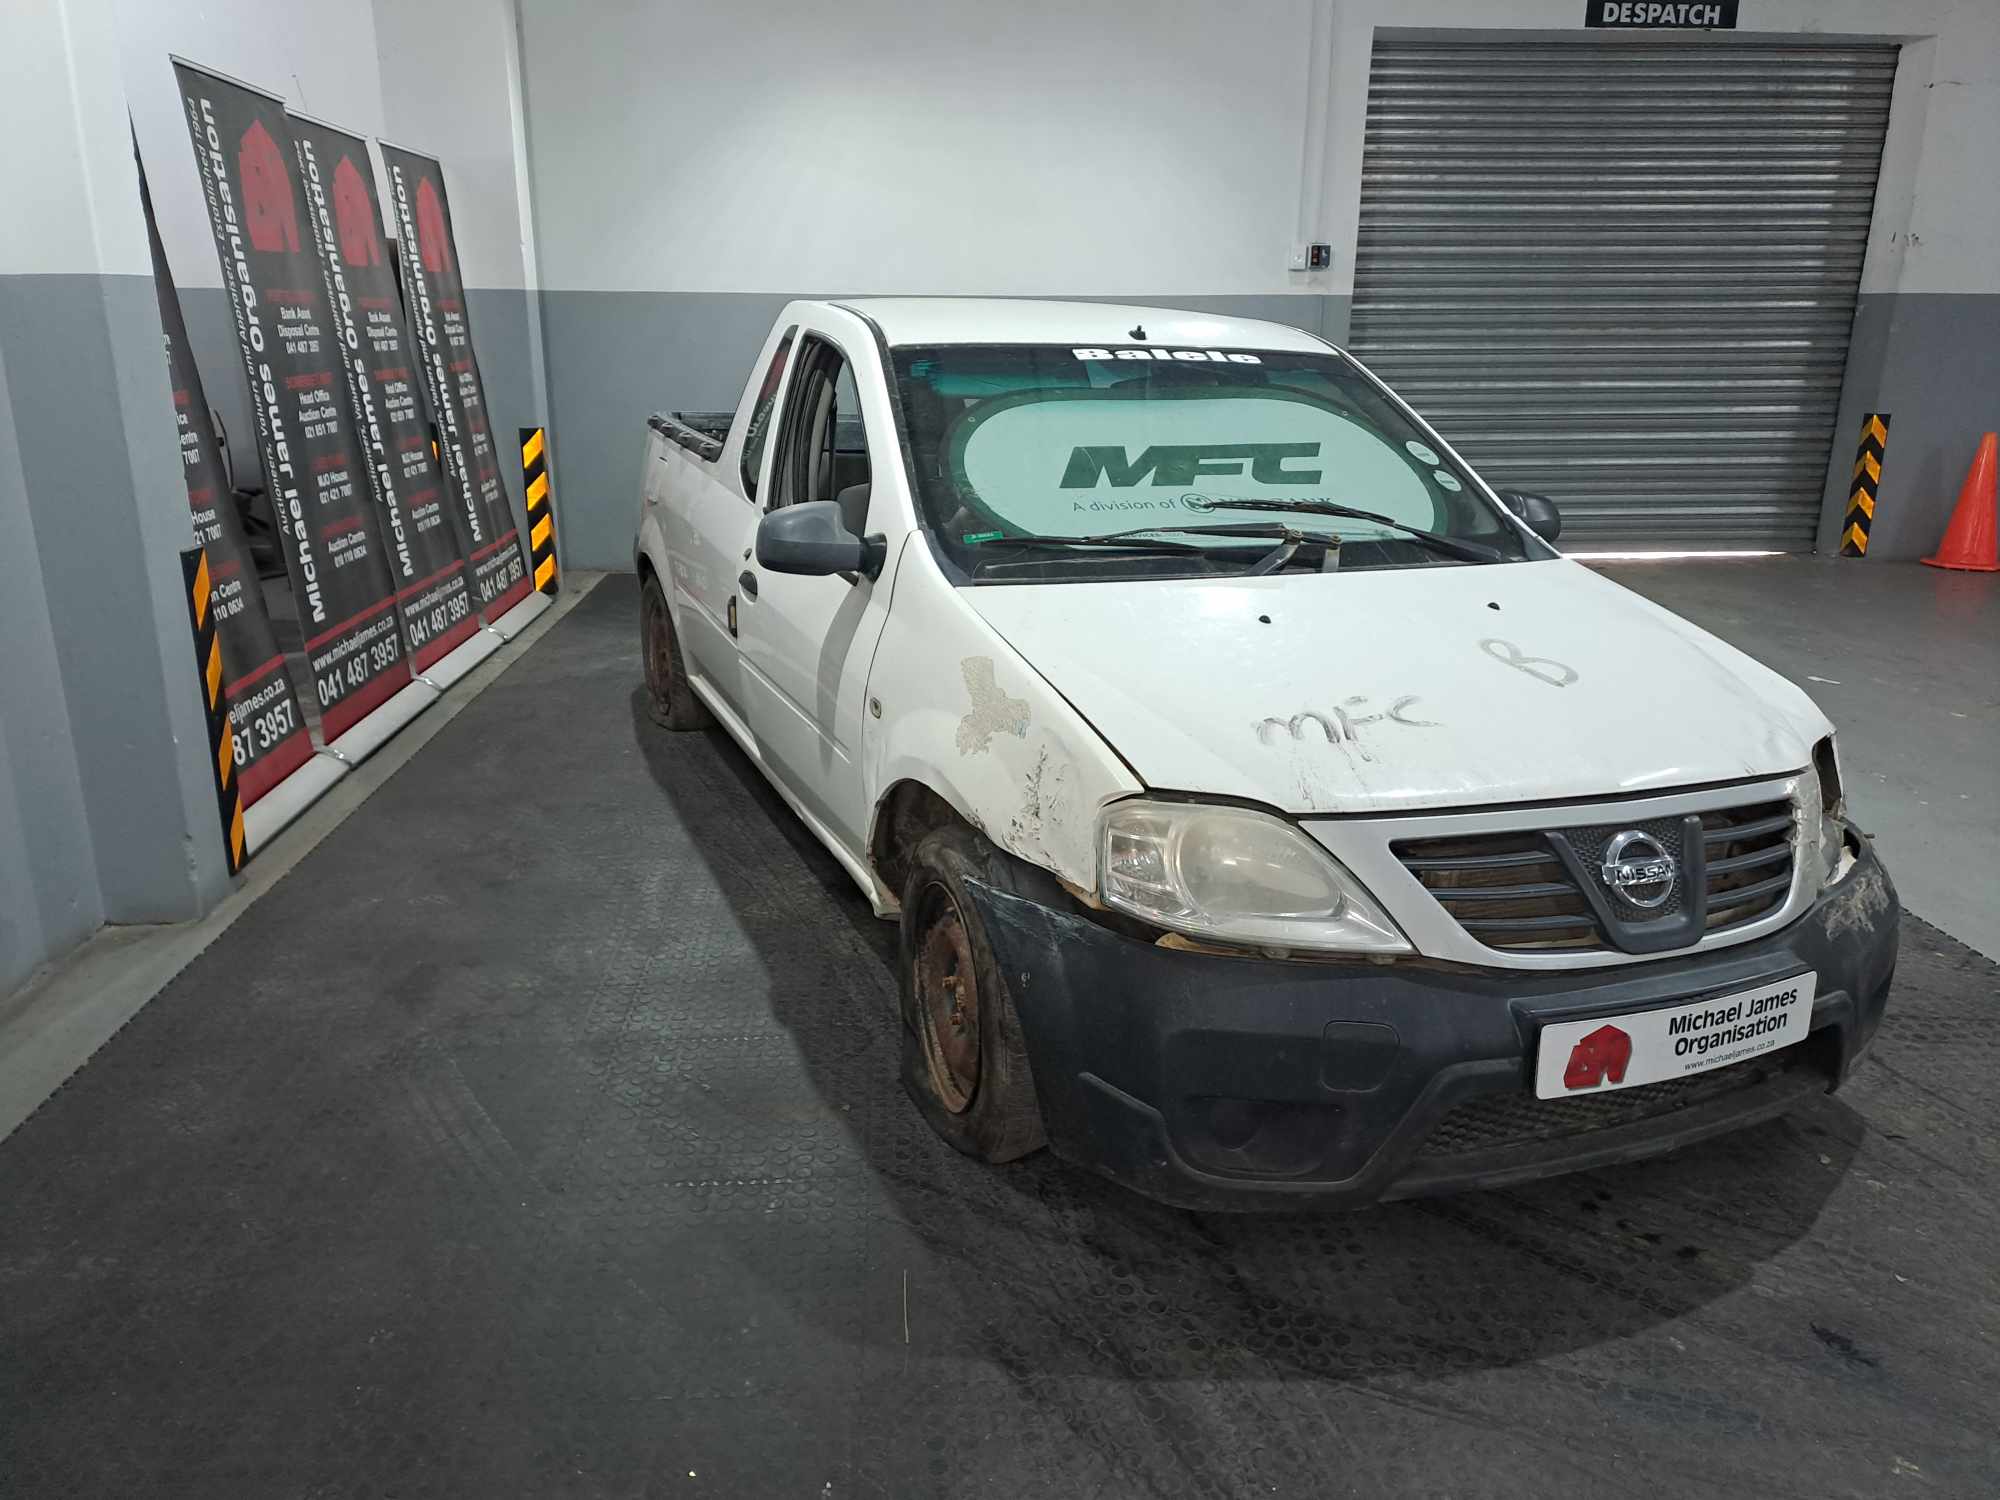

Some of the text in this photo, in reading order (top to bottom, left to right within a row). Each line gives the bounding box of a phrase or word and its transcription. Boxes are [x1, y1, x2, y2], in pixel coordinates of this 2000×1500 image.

[1602, 2, 1721, 25] DESPATCH
[187, 96, 202, 140] 1964
[198, 142, 225, 241] Established
[303, 139, 358, 350] Organisation
[393, 165, 436, 346] Organisation
[223, 255, 247, 342] Appraisers
[200, 98, 326, 624] Michael James Organisation
[242, 343, 254, 375] and
[339, 342, 350, 369] and
[251, 380, 268, 437] Valuers
[354, 358, 384, 455] James
[432, 353, 458, 437] James
[180, 431, 199, 445] entre
[1058, 442, 1322, 488] MFC
[192, 508, 216, 526] House
[451, 444, 482, 542] Michael
[1072, 498, 1177, 512] A division of
[205, 523, 222, 542] 7007
[377, 463, 414, 577] Michael
[219, 579, 242, 598] Centre
[480, 576, 497, 602] 041
[496, 568, 507, 592] 487
[213, 597, 245, 622] 110 0634
[409, 591, 470, 646] 041 487 3957
[312, 615, 394, 672] www.michaeljames.co.za
[317, 633, 399, 706] 041 487 3957
[229, 677, 286, 725] eljames.co.za
[232, 698, 294, 766] 87 3957
[1614, 863, 1674, 881] NISSAN
[1668, 988, 1798, 1036] Michael James
[1674, 1012, 1788, 1056] Organisation
[1684, 1039, 1775, 1071] www.michaeljames.co.za
